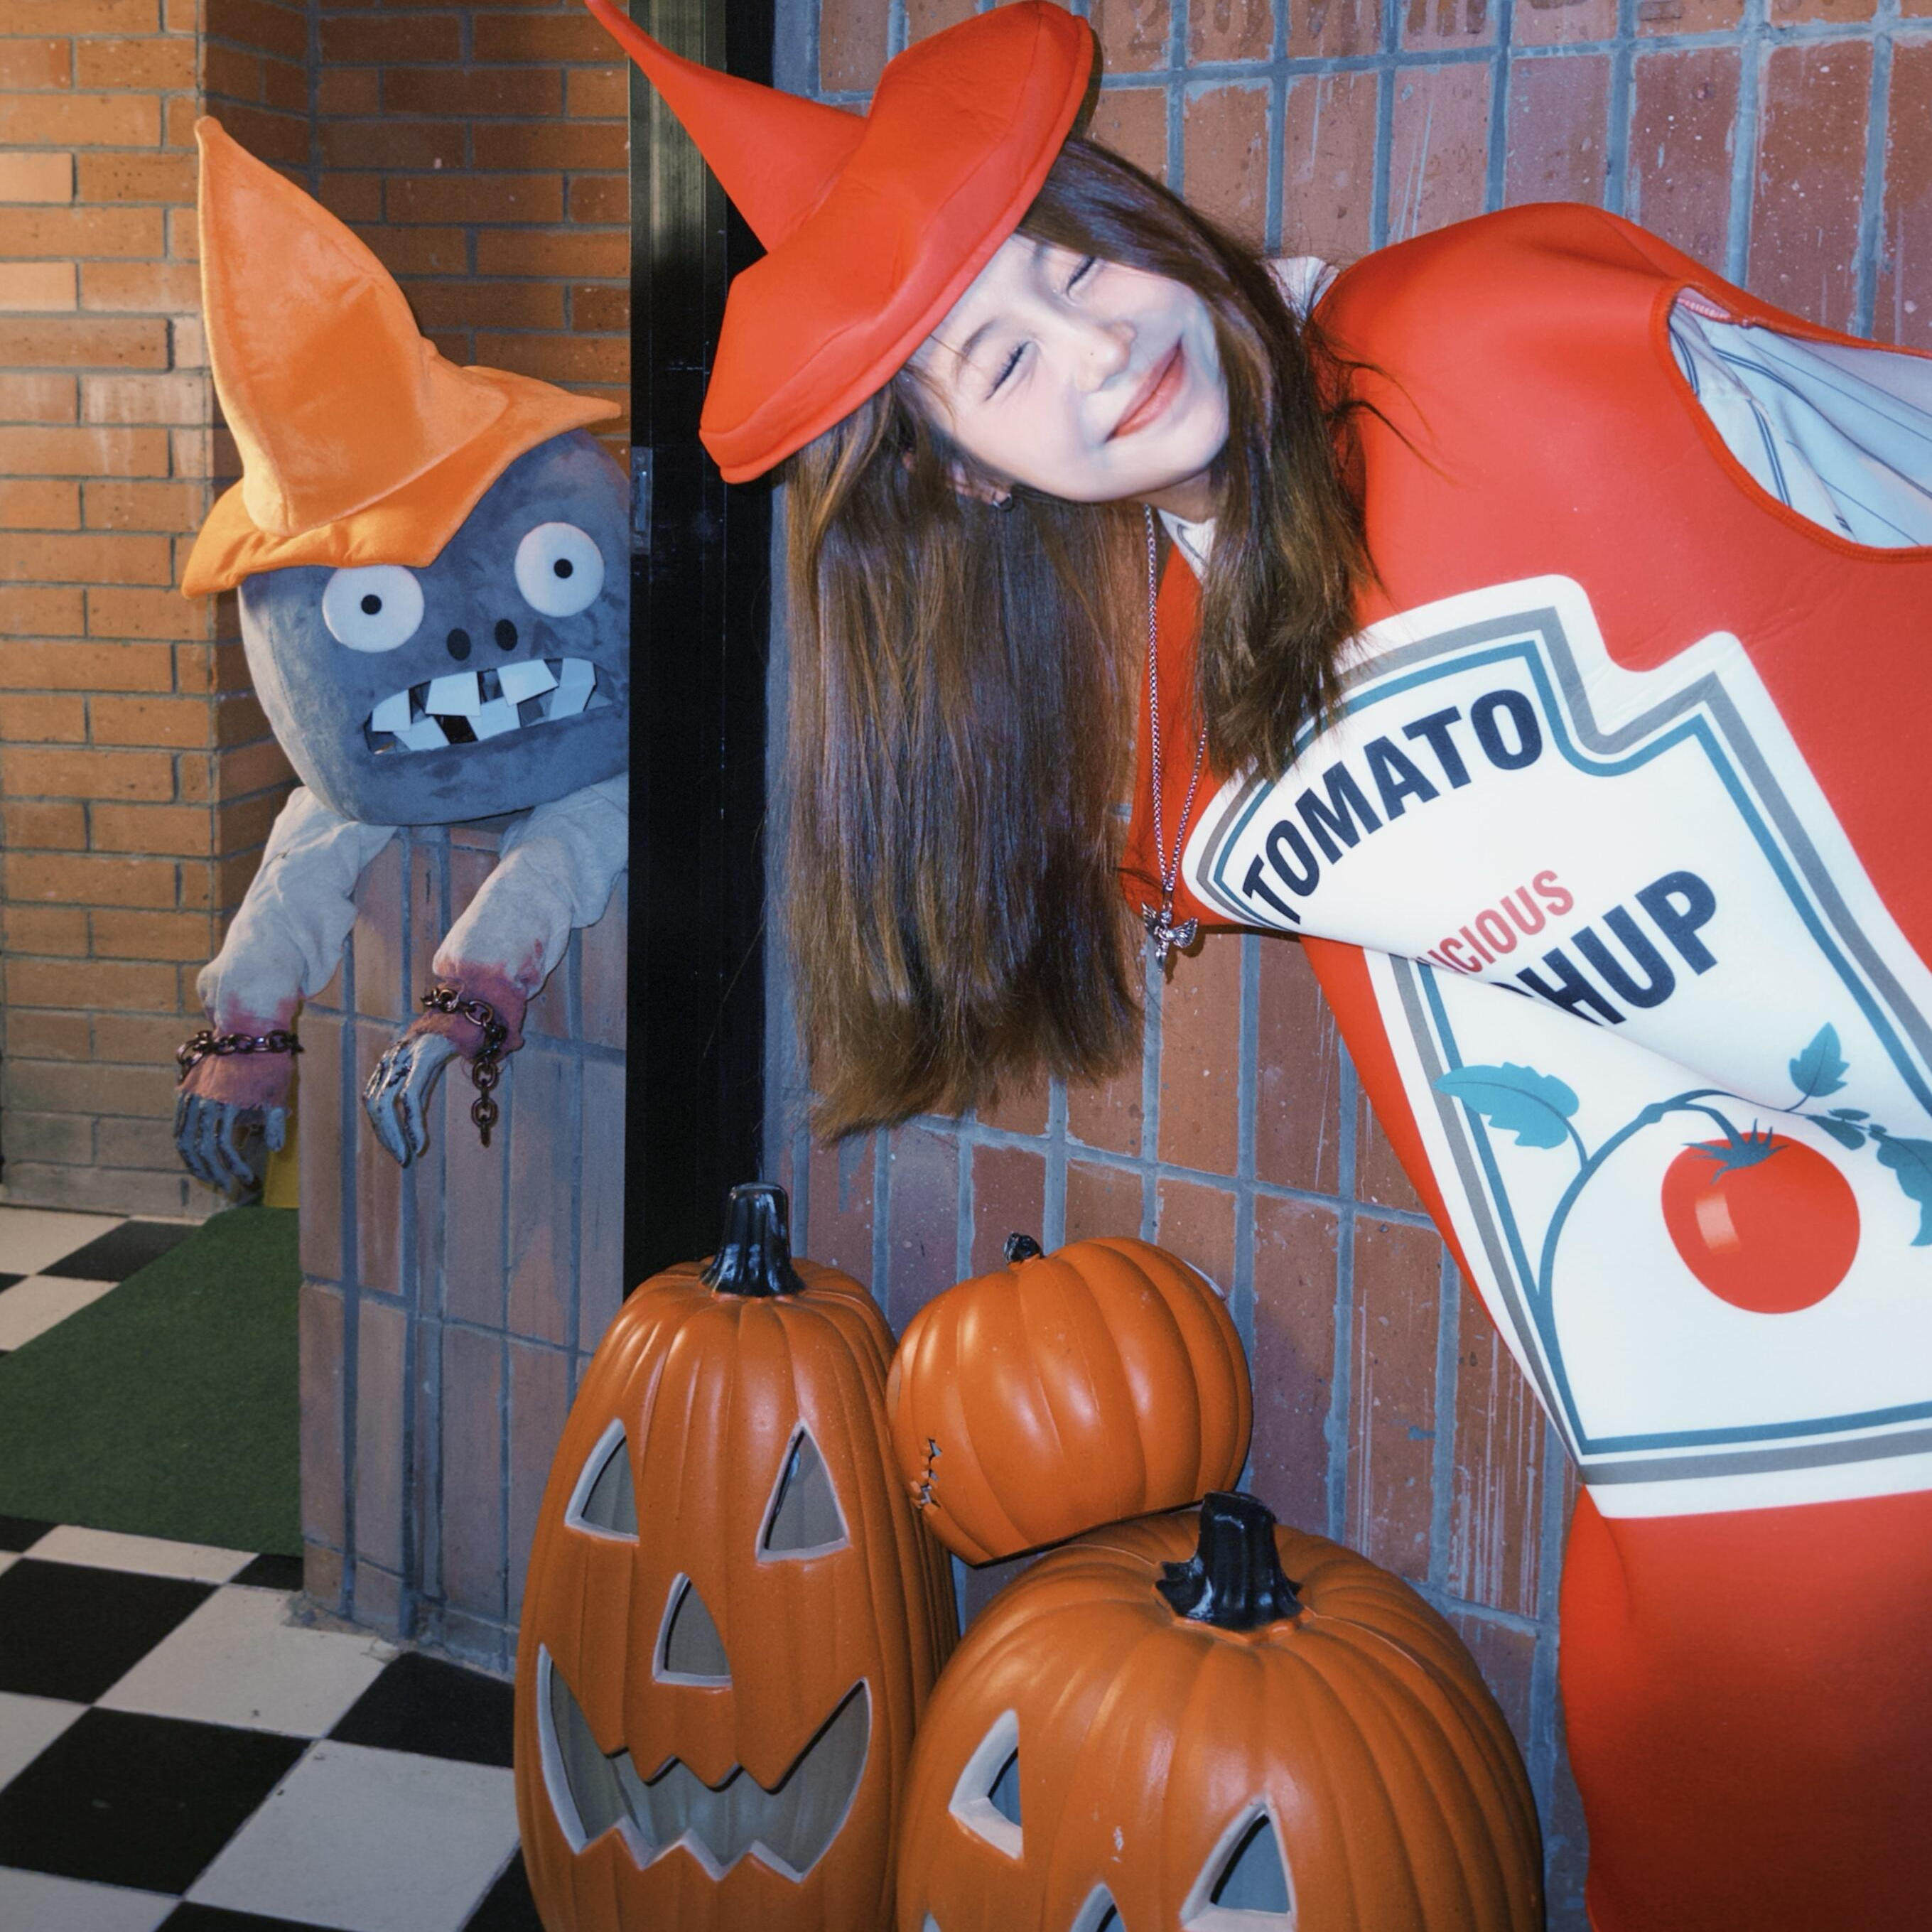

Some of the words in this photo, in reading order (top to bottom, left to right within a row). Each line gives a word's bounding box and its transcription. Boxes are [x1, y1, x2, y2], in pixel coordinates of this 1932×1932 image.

[1242, 689, 1543, 925] TOMATO
[1417, 870, 1574, 975] ICIOUS
[1489, 870, 1718, 1027] HUP
